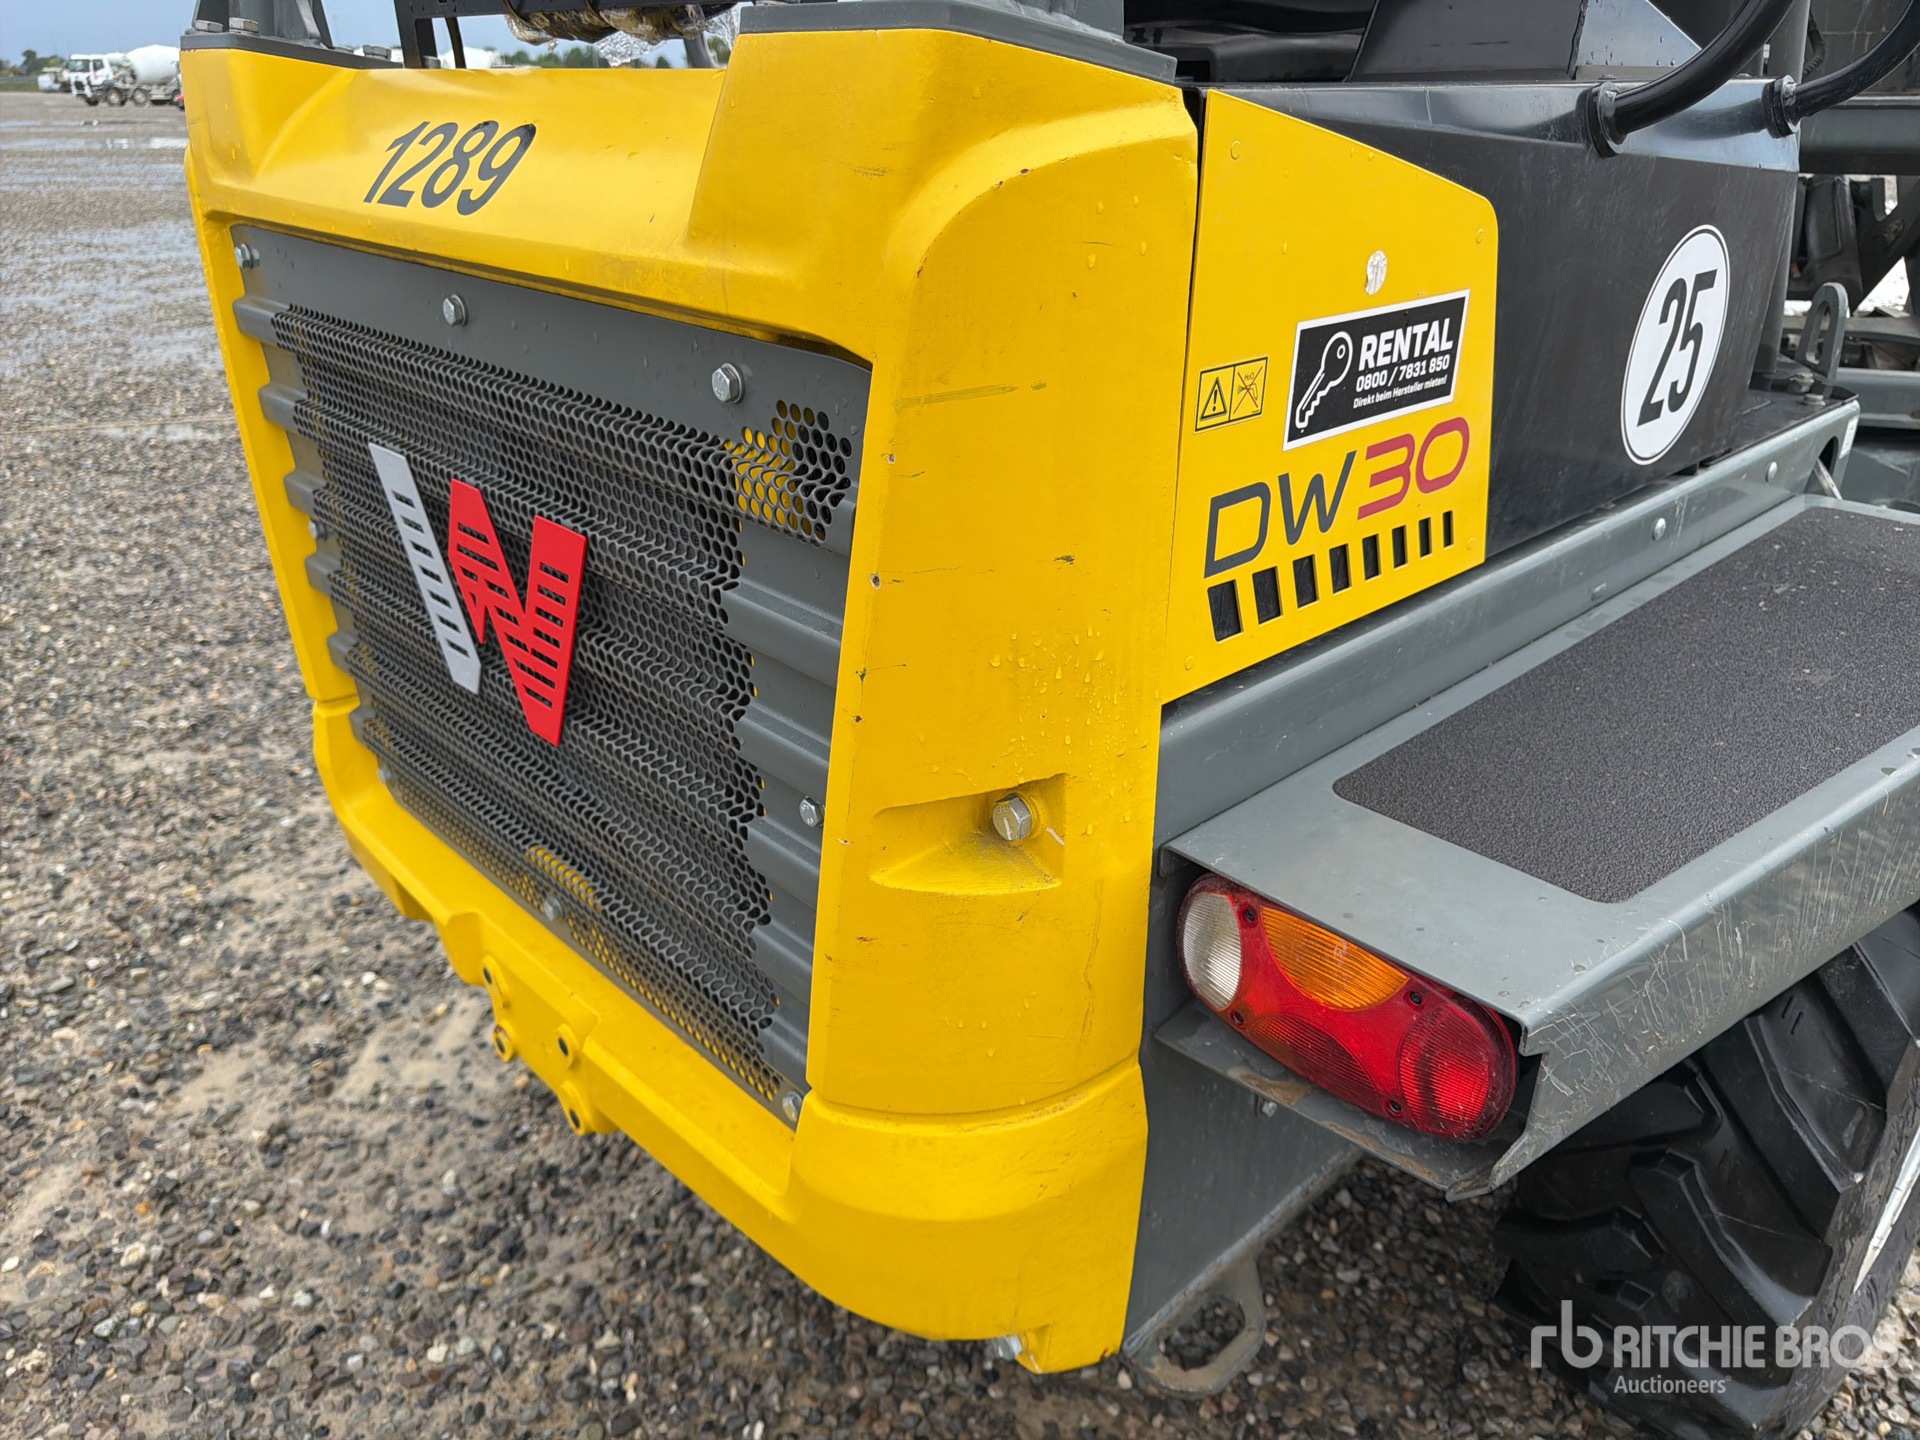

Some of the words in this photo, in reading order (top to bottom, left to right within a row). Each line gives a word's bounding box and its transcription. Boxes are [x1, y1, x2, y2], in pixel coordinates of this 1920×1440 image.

[363, 120, 537, 216] 1289
[1355, 370, 1388, 392] 0800
[1398, 360, 1427, 381] 7831
[1428, 354, 1450, 374] 850
[1358, 318, 1454, 371] RENTAL
[1636, 268, 1718, 427] 25
[1353, 394, 1375, 409] Direkt
[1375, 389, 1392, 403] beim
[1392, 381, 1424, 398] Hersteller
[1424, 374, 1448, 390] mieten!
[1203, 416, 1470, 579] DW30
